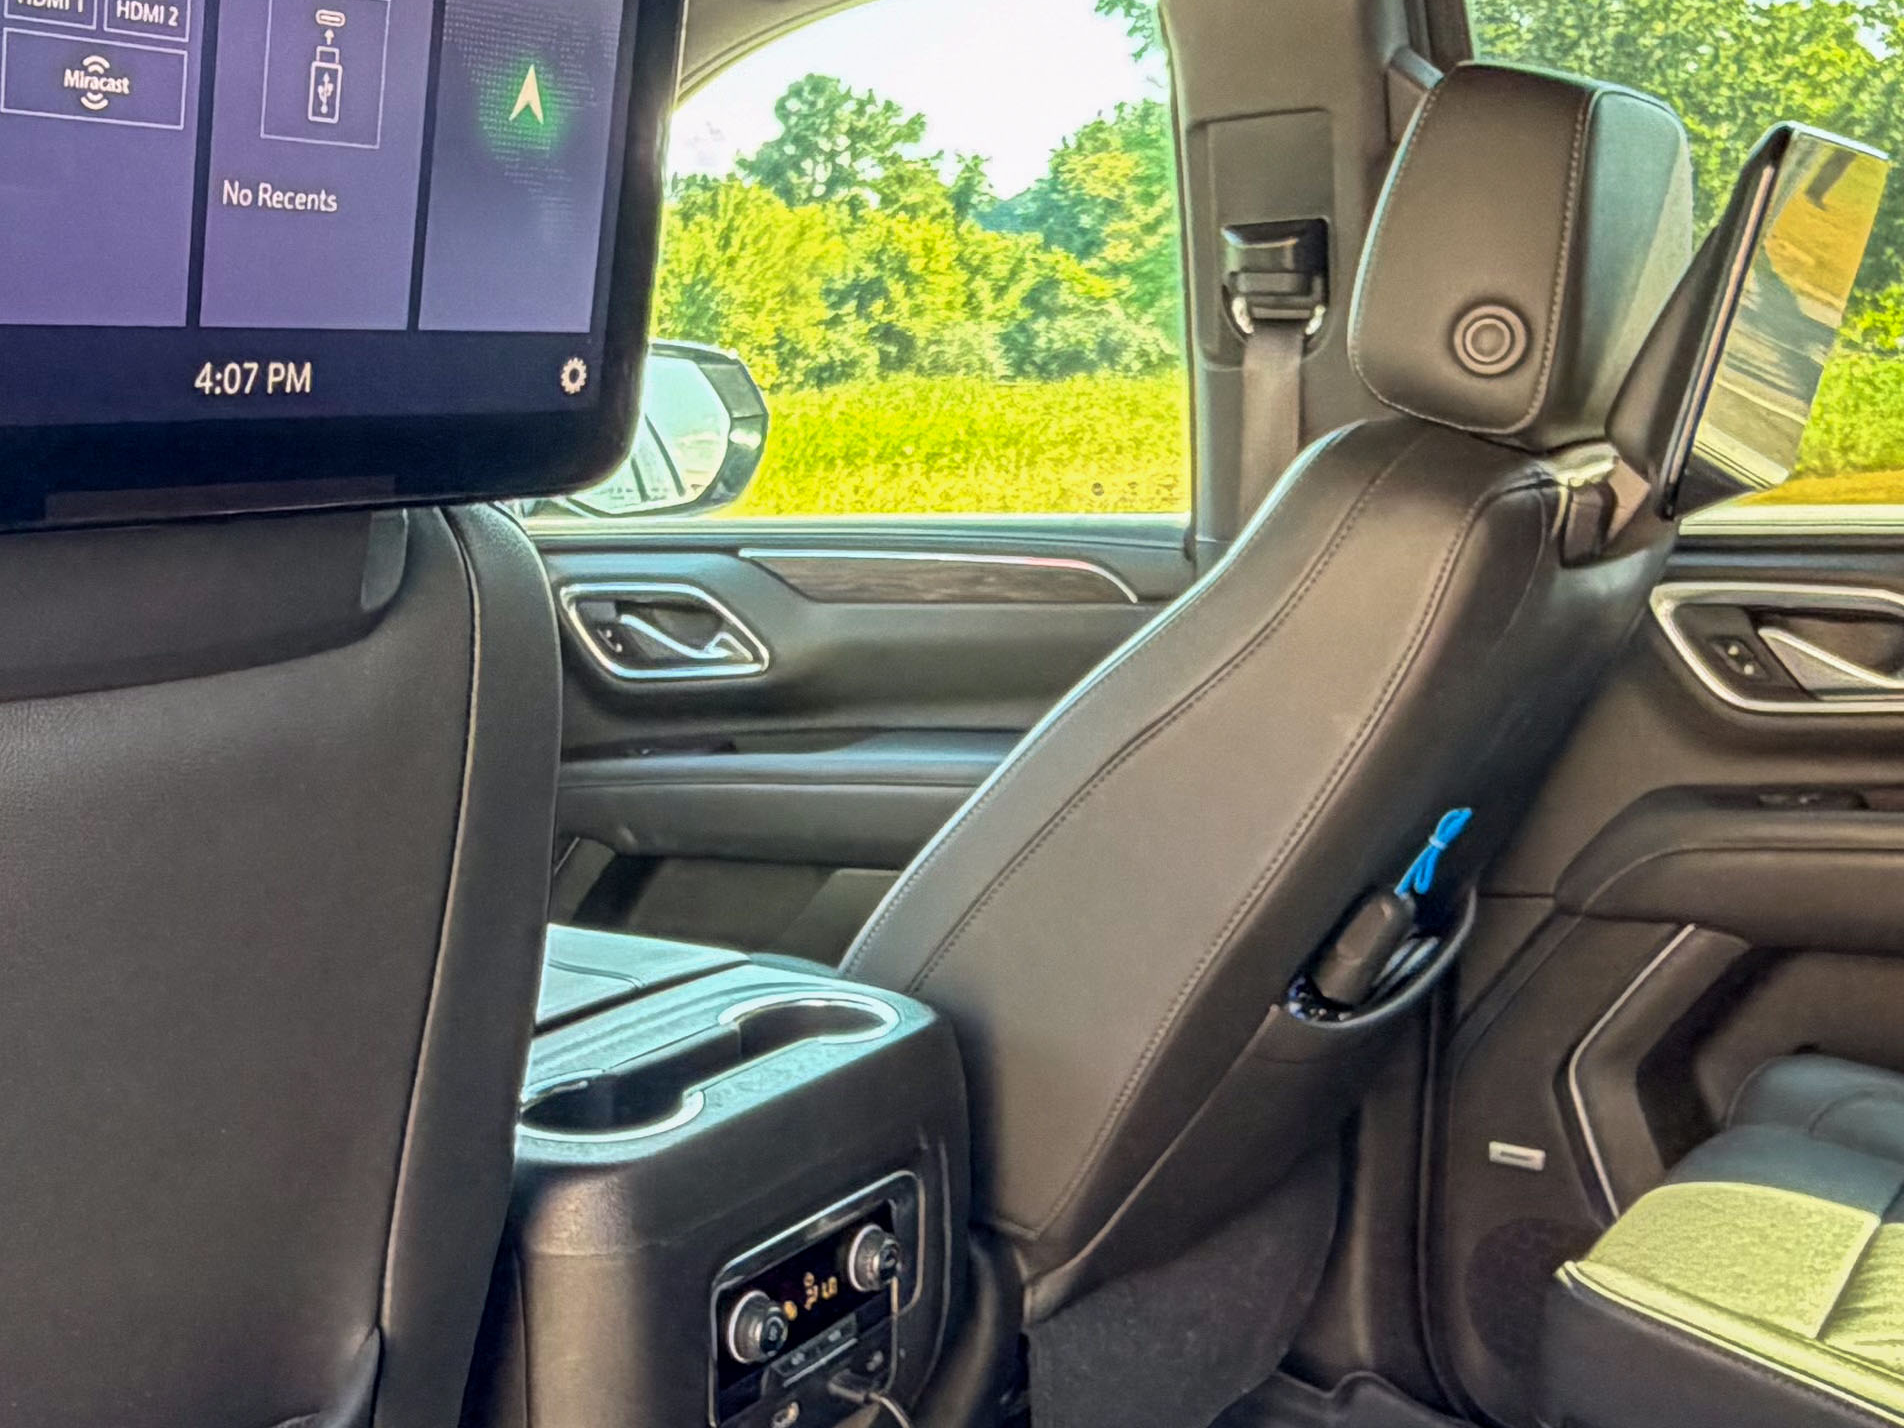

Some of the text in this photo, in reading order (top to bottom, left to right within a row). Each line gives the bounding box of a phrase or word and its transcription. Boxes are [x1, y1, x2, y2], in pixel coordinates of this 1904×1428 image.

[116, 0, 179, 27] HDMI 2
[63, 69, 130, 95] Miracast
[222, 179, 338, 212] No Recents
[194, 361, 312, 395] 4:07 PM
